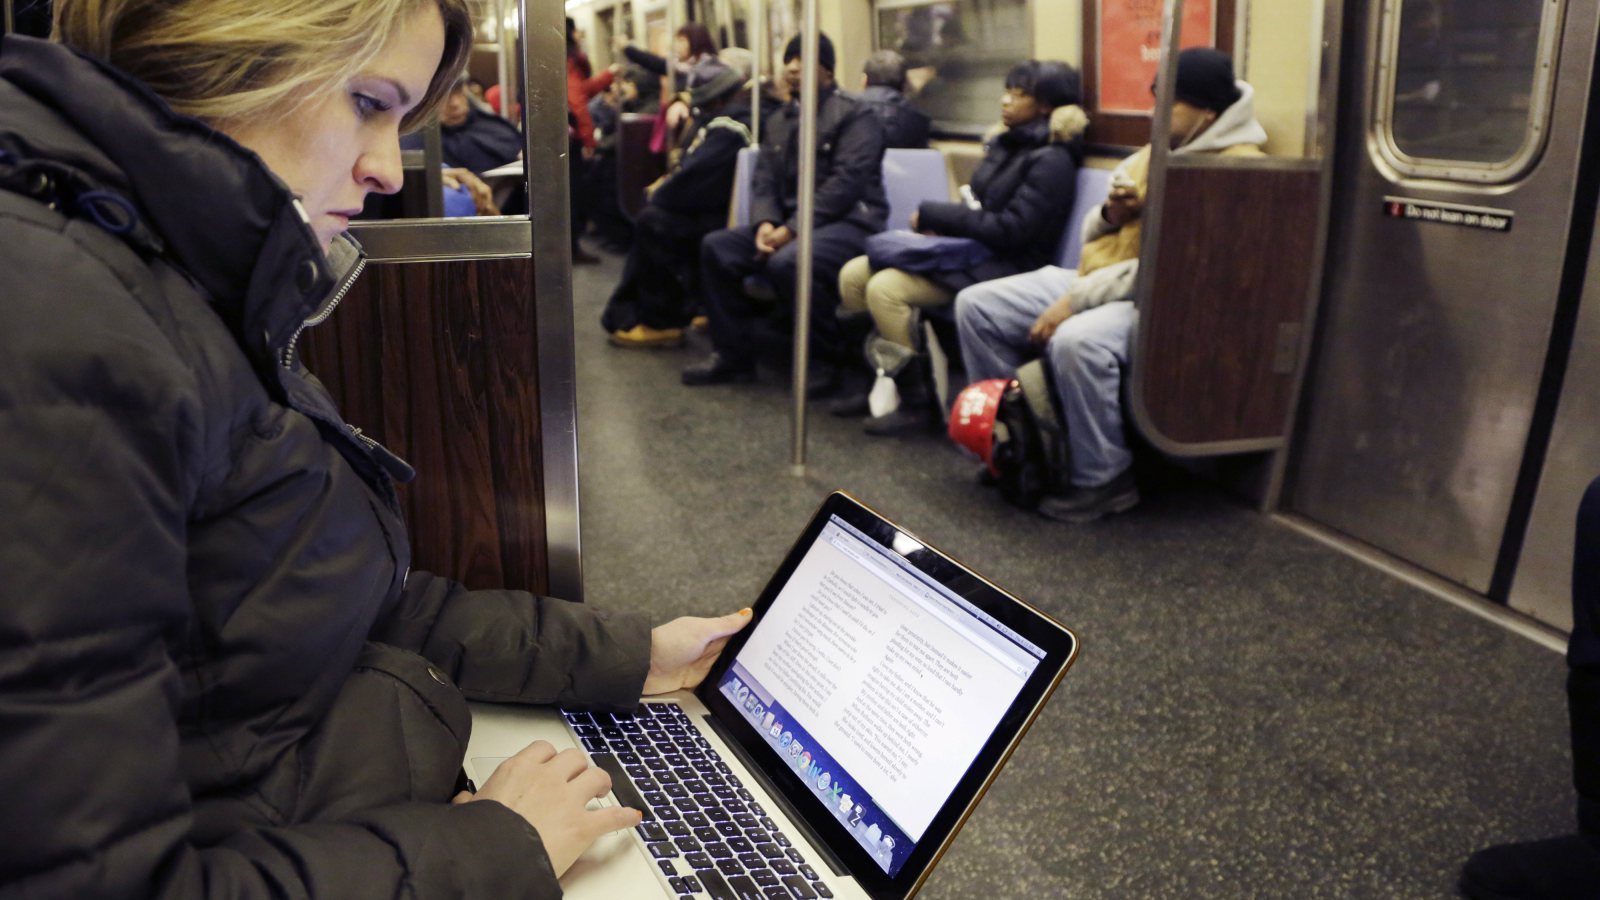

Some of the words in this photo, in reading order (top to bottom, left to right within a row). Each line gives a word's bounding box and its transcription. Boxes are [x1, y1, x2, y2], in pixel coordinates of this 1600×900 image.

[1407, 204, 1421, 218] Do
[1423, 207, 1440, 220] not
[1441, 210, 1463, 223] lean
[1465, 214, 1480, 225] on
[1481, 214, 1507, 228] door
